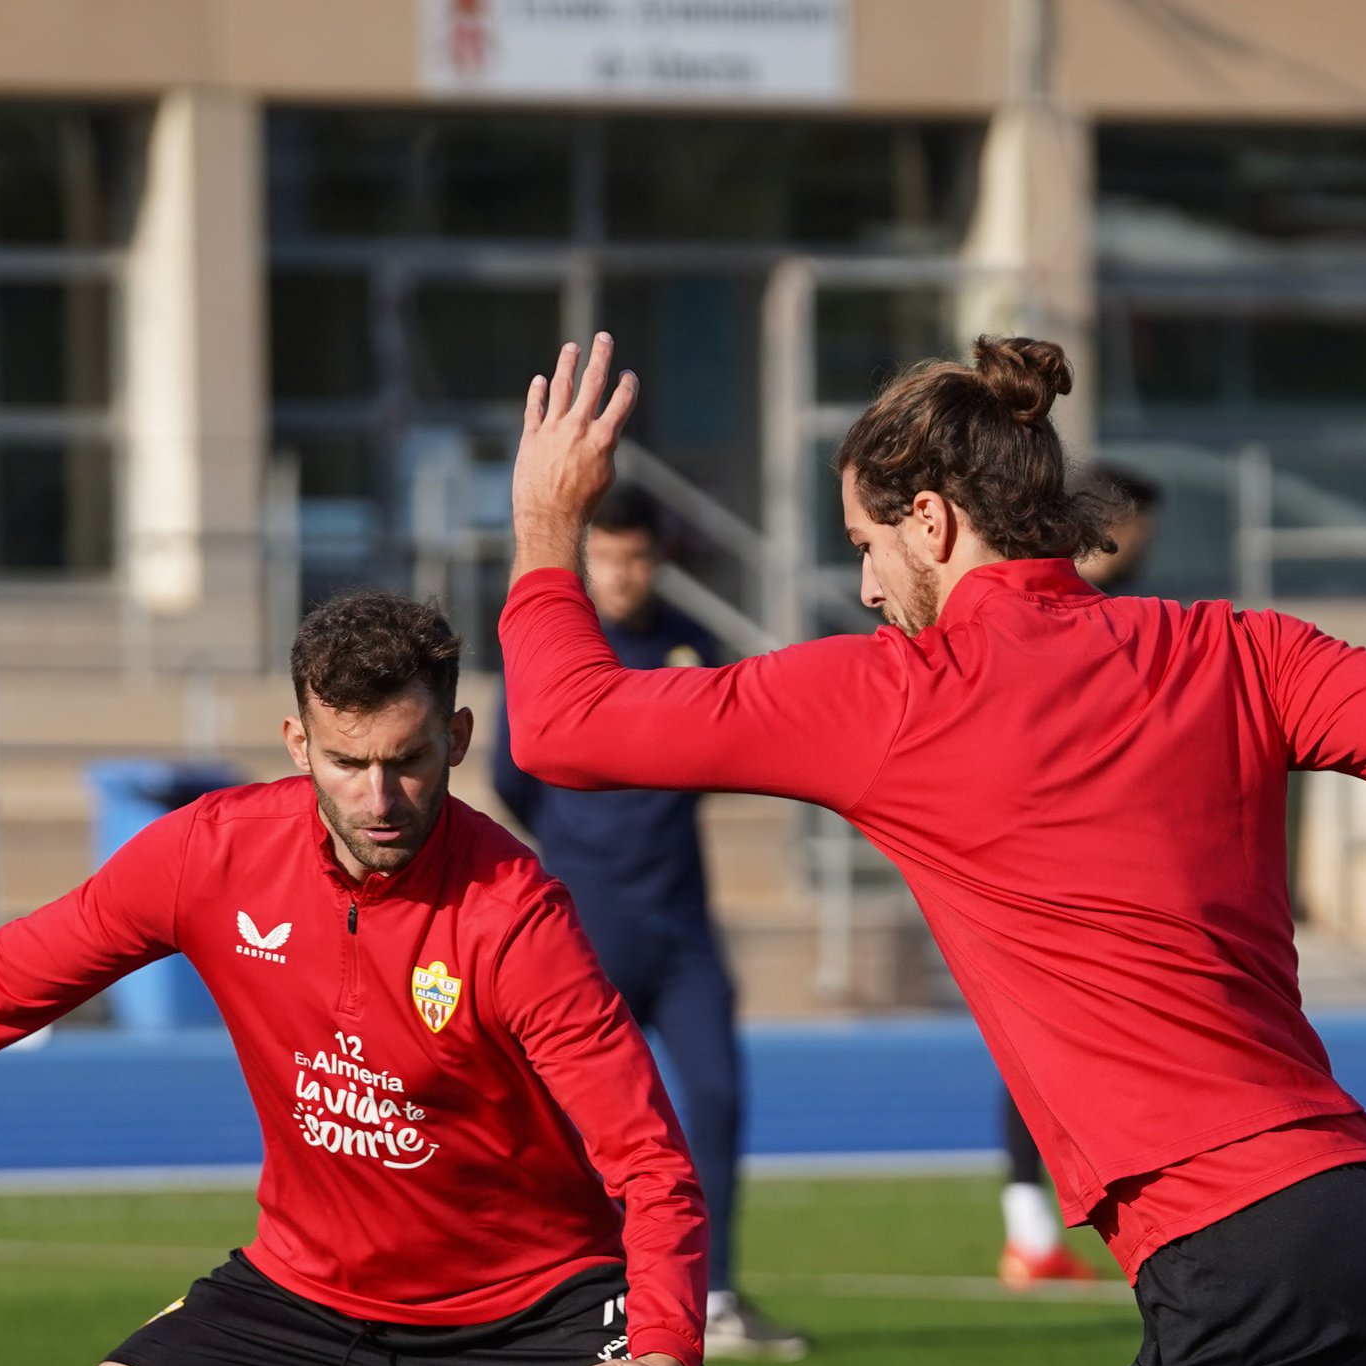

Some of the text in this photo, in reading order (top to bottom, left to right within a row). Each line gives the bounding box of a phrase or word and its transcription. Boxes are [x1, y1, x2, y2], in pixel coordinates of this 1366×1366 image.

[235, 944, 287, 964] CASTORE
[334, 1030, 365, 1063] 12
[294, 1051, 405, 1093] En Almería
[295, 1071, 426, 1124] la vida te
